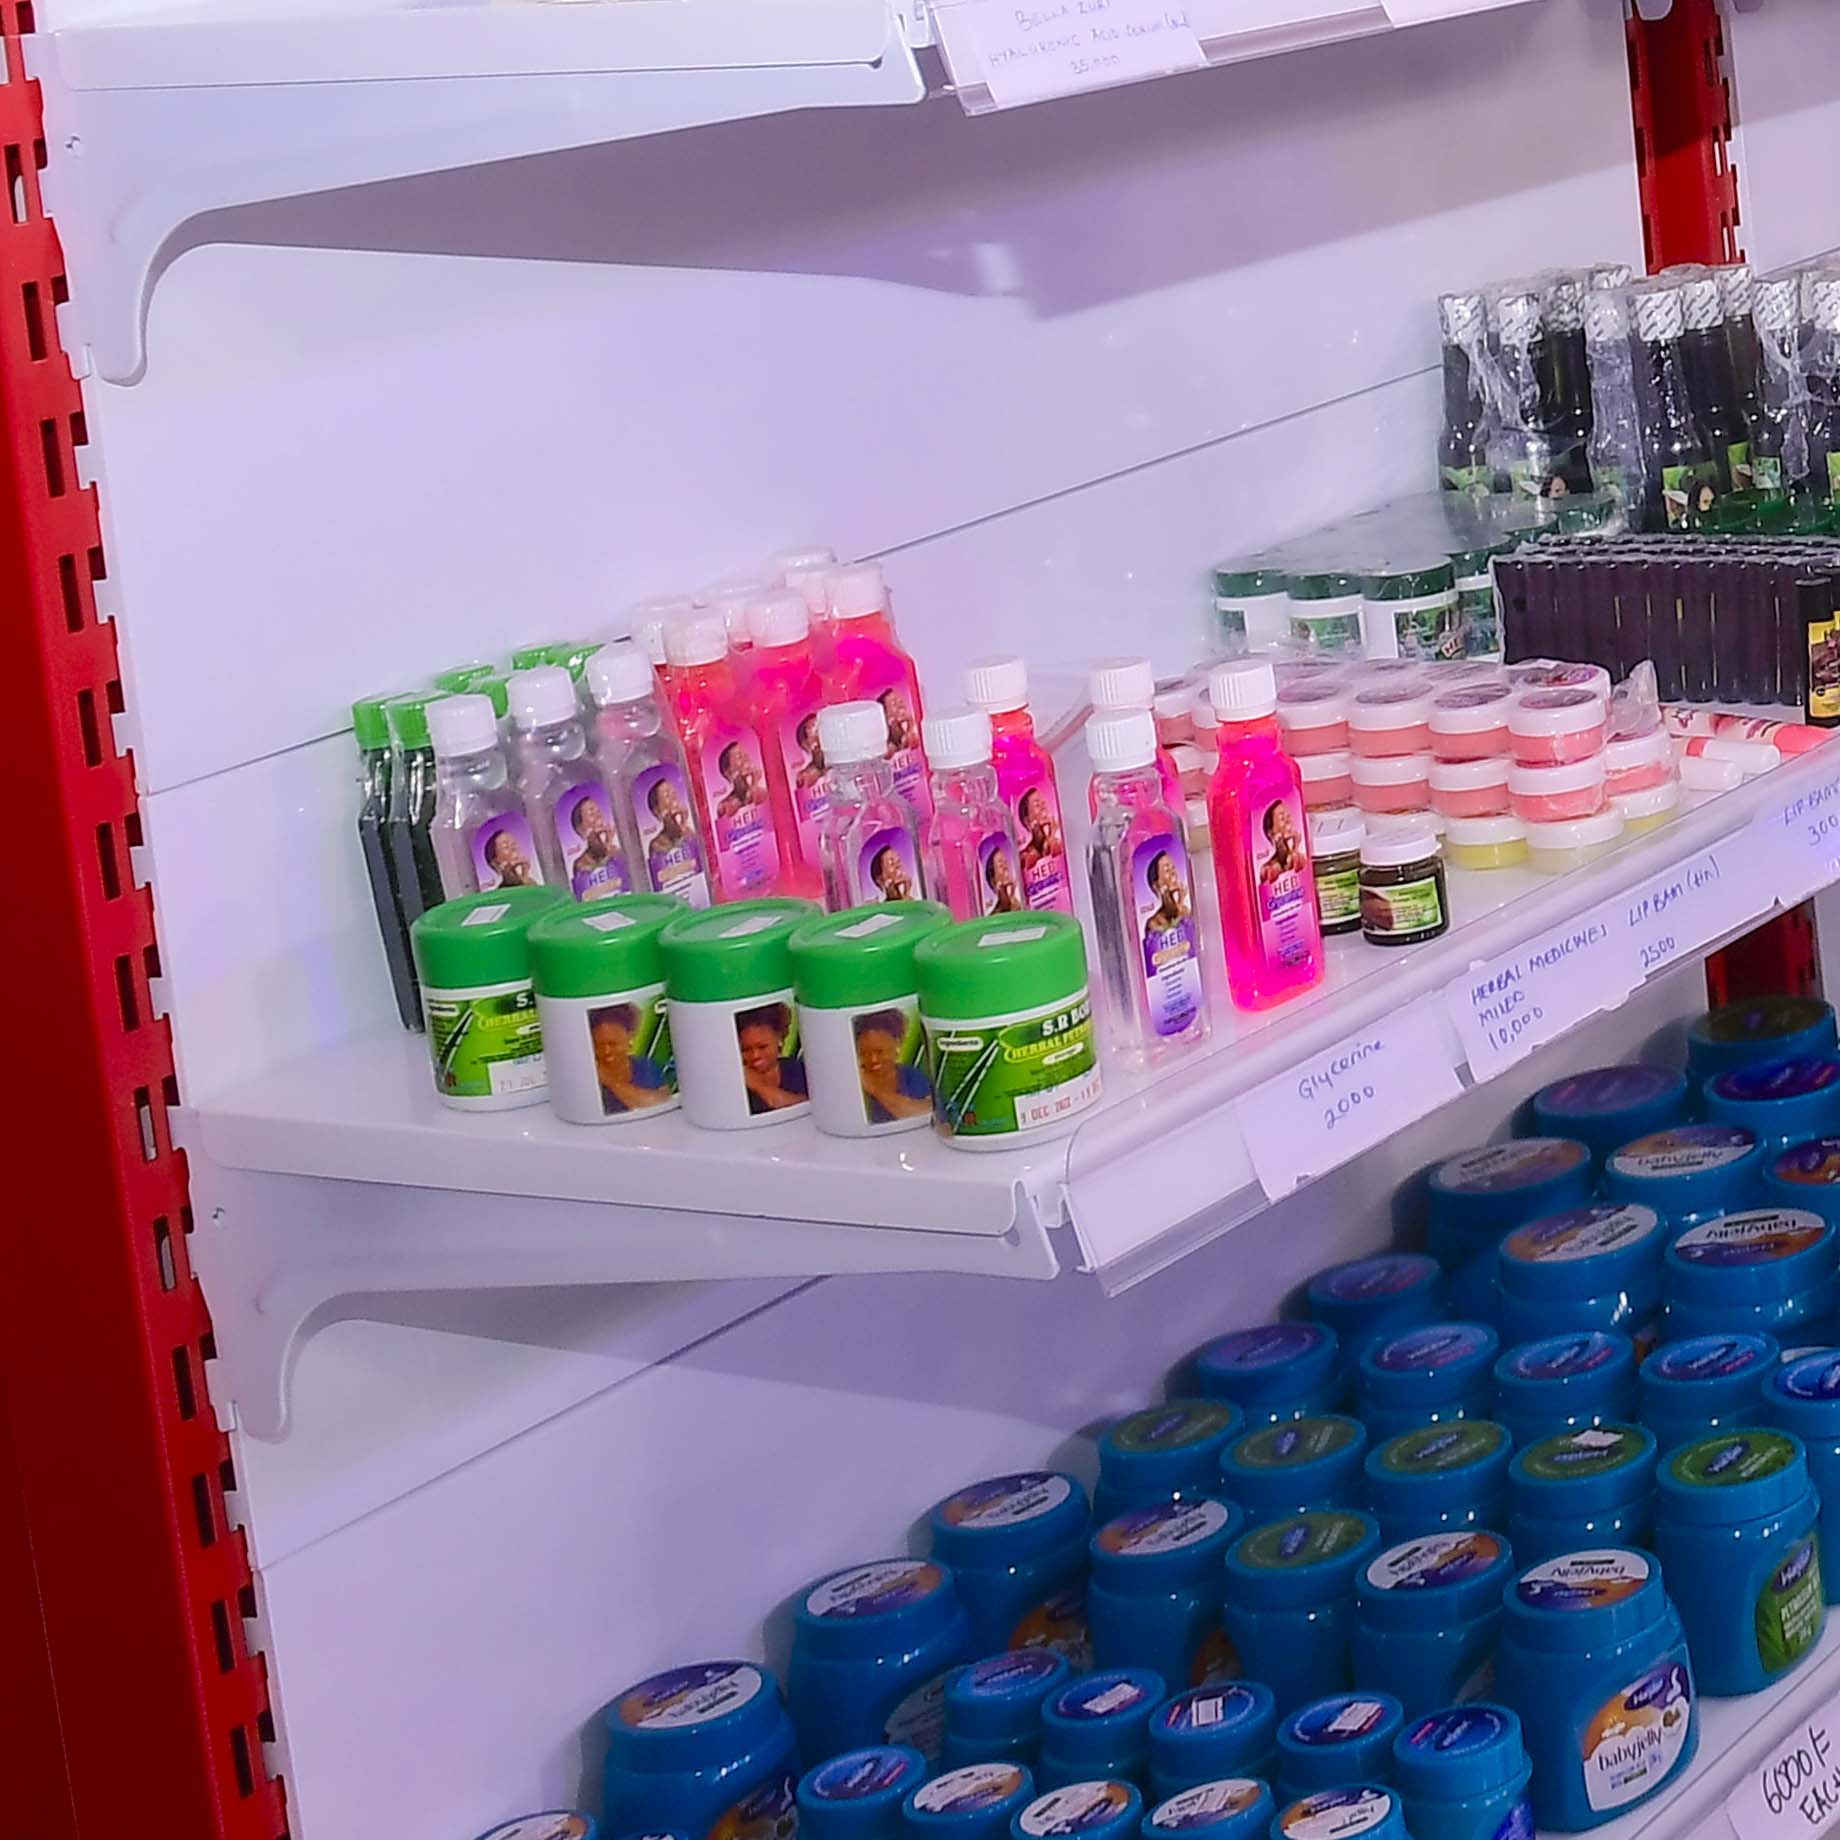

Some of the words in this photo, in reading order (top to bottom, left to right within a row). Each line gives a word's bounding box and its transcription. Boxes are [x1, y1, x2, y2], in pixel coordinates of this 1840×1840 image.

[1628, 899, 1650, 927] LIP
[1638, 935, 1676, 969] 2500
[1471, 964, 1523, 1006] HERBAL
[1487, 1006, 1545, 1052] 10,000
[1323, 1084, 1375, 1130] 2000
[1598, 1725, 1663, 1772] babyjelly
